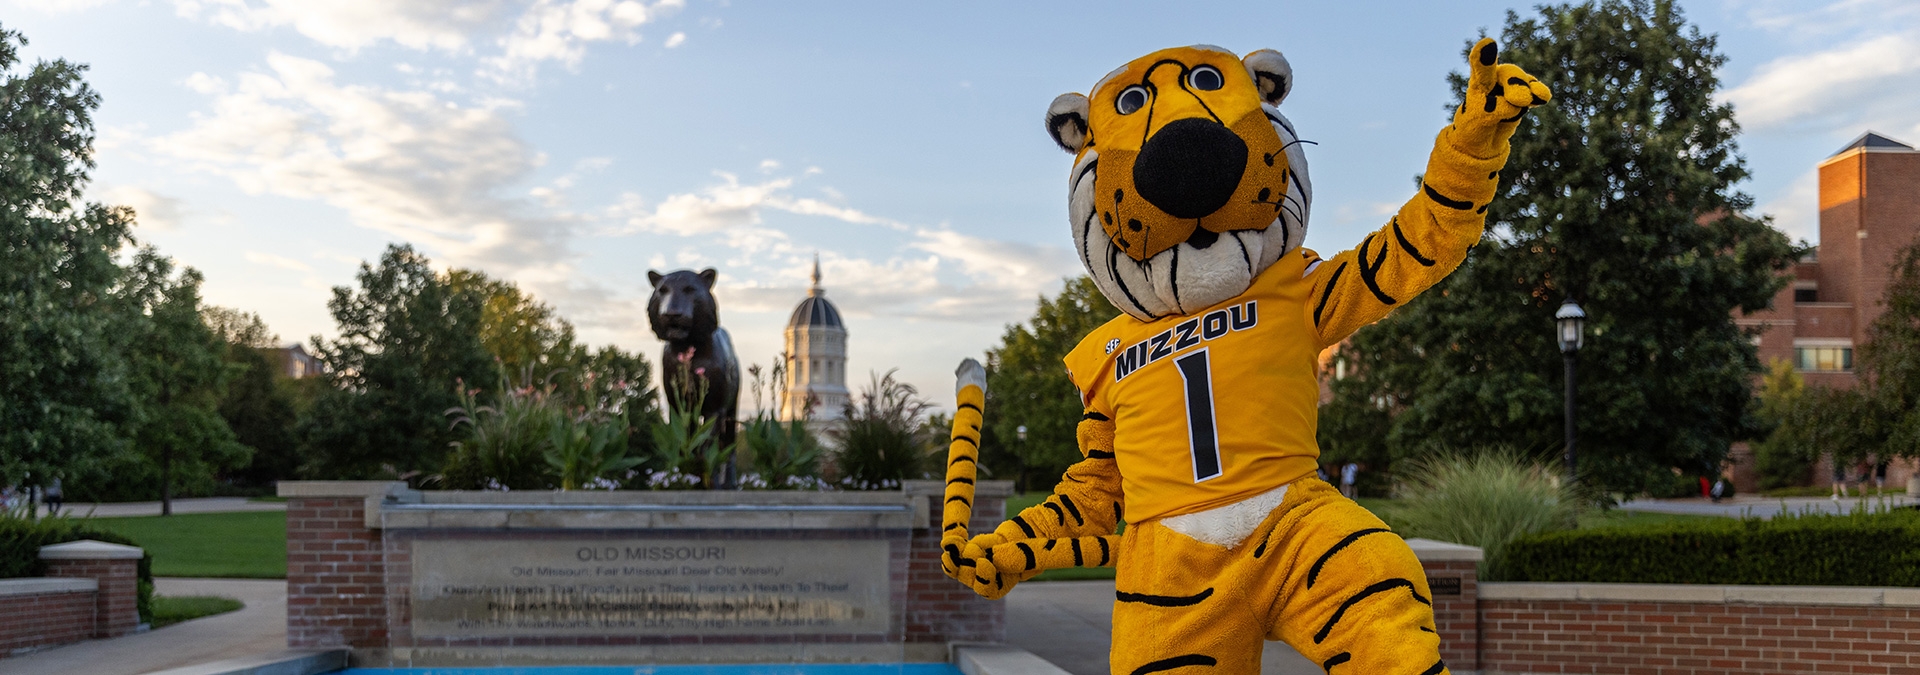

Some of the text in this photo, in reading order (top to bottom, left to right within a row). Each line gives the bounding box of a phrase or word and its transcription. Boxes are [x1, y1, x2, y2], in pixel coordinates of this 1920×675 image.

[1105, 338, 1121, 354] SEC
[1114, 300, 1258, 383] MIZZOU
[1172, 346, 1223, 484] 1
[576, 546, 726, 562] OLD MISSOURI
[511, 565, 533, 578] Old
[596, 565, 618, 577] Fair
[682, 565, 711, 577] Dear
[715, 565, 737, 577] Old
[741, 583, 750, 594] A
[754, 583, 793, 594] Health
[797, 583, 811, 594] To
[488, 602, 525, 613] Proud
